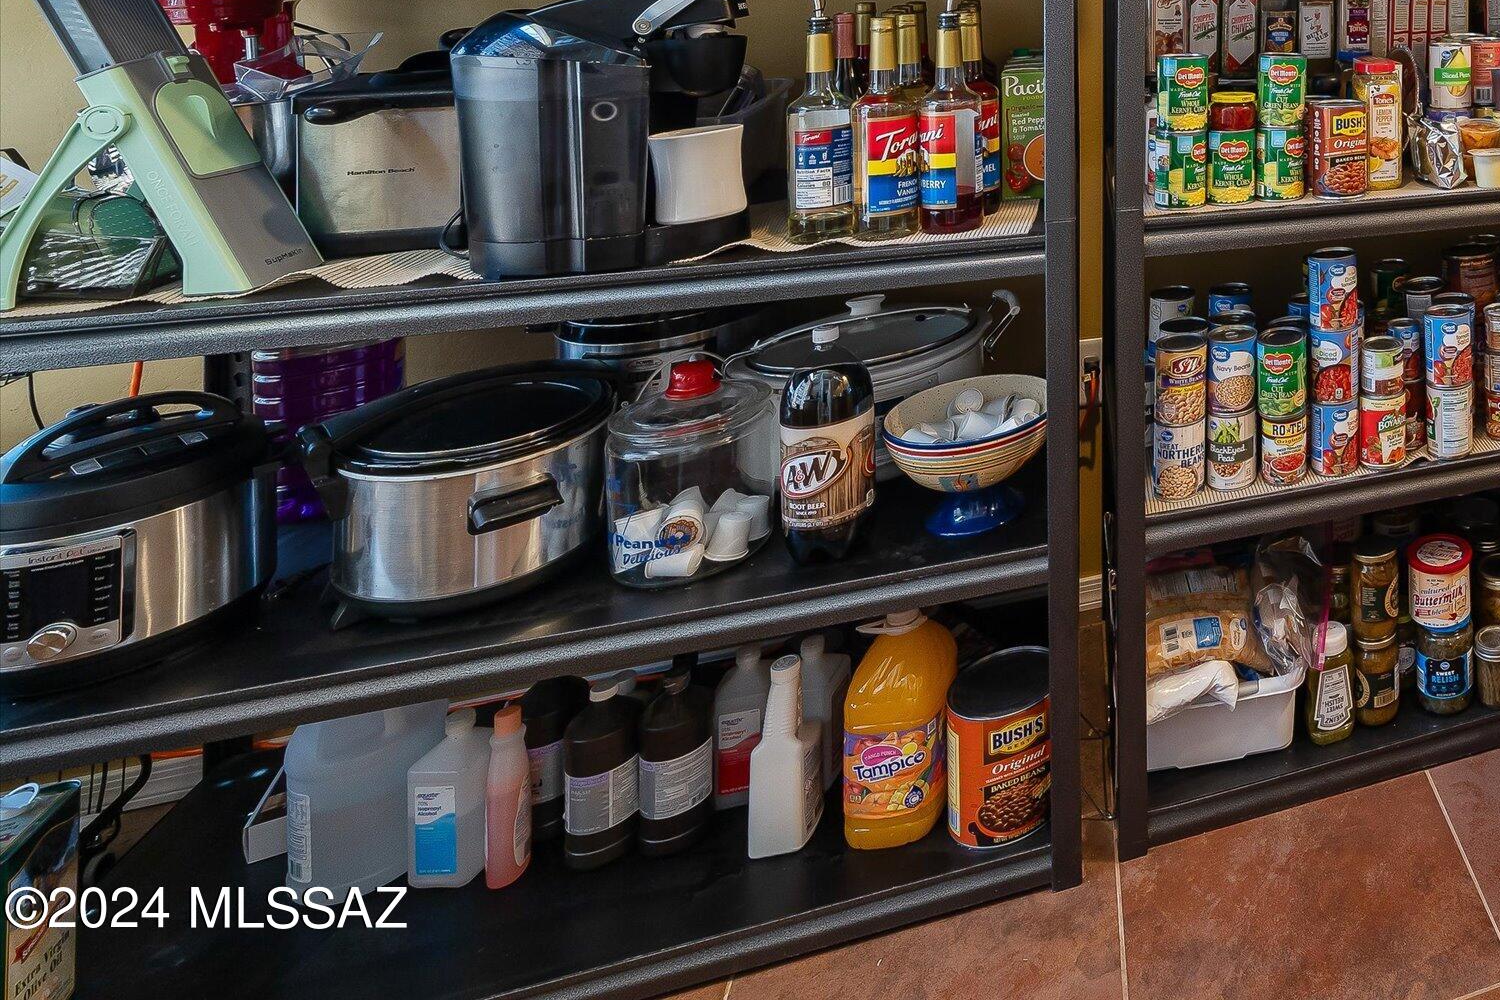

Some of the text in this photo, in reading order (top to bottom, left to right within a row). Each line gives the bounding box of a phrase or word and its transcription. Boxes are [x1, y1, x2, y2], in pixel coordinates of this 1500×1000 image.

[1218, 454, 1235, 462] Peas
[807, 501, 826, 509] BEER
[1432, 674, 1459, 683] RELISH
[992, 716, 1045, 751] BUSH'S
[853, 750, 926, 781] Tampico
[991, 744, 1046, 776] Original
[991, 766, 1046, 793] BAKED BEANS
